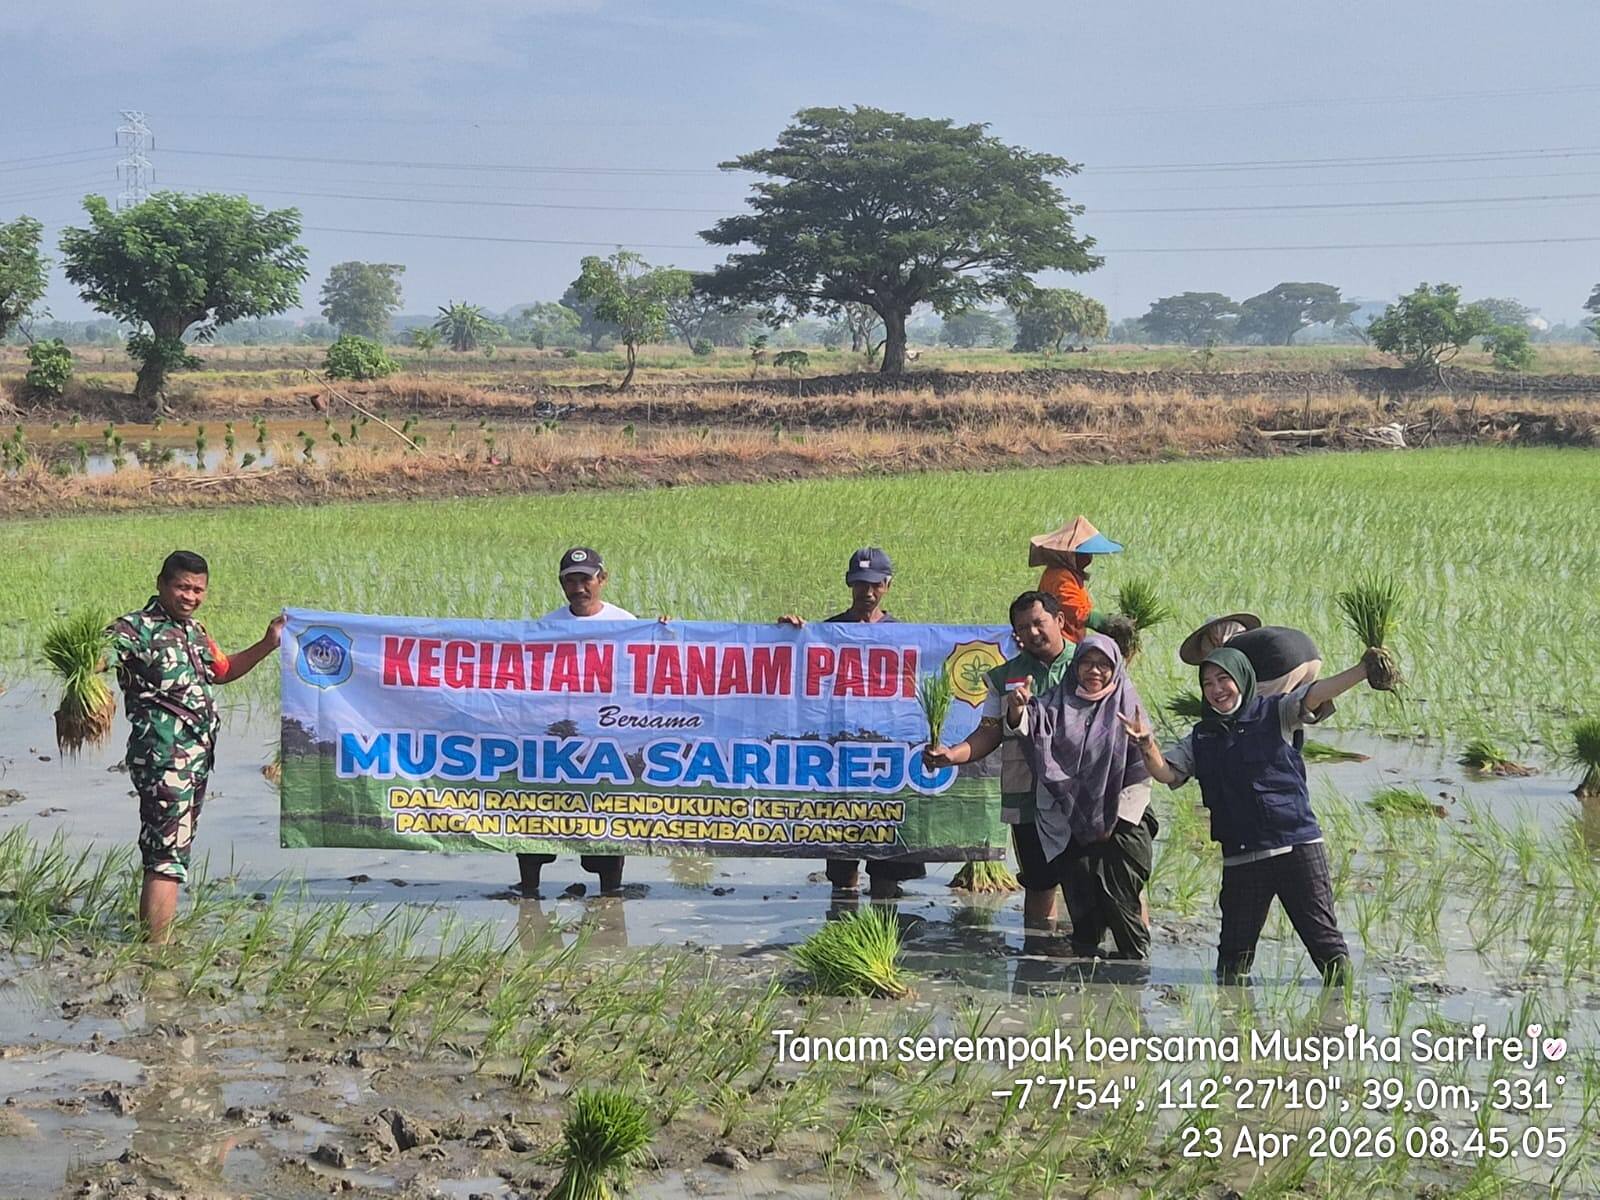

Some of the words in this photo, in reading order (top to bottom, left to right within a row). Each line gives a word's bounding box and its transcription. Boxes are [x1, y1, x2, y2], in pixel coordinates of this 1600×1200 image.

[382, 636, 614, 694] KEGIATAN
[628, 644, 792, 696] TANAM
[805, 646, 918, 698] PADI
[597, 705, 703, 729] Bersama
[339, 732, 629, 780] MUSPIKA
[645, 740, 956, 791] SARIREJO
[390, 788, 481, 810] DALAM
[485, 790, 588, 813] RANGKA
[592, 794, 749, 818] MENDUKUNG
[753, 799, 904, 822] KETAHANAN
[396, 813, 501, 835] PANGAN
[506, 815, 608, 837] MENUJU
[609, 818, 791, 844] SWASEMBADA
[791, 824, 897, 845] PANGAN
